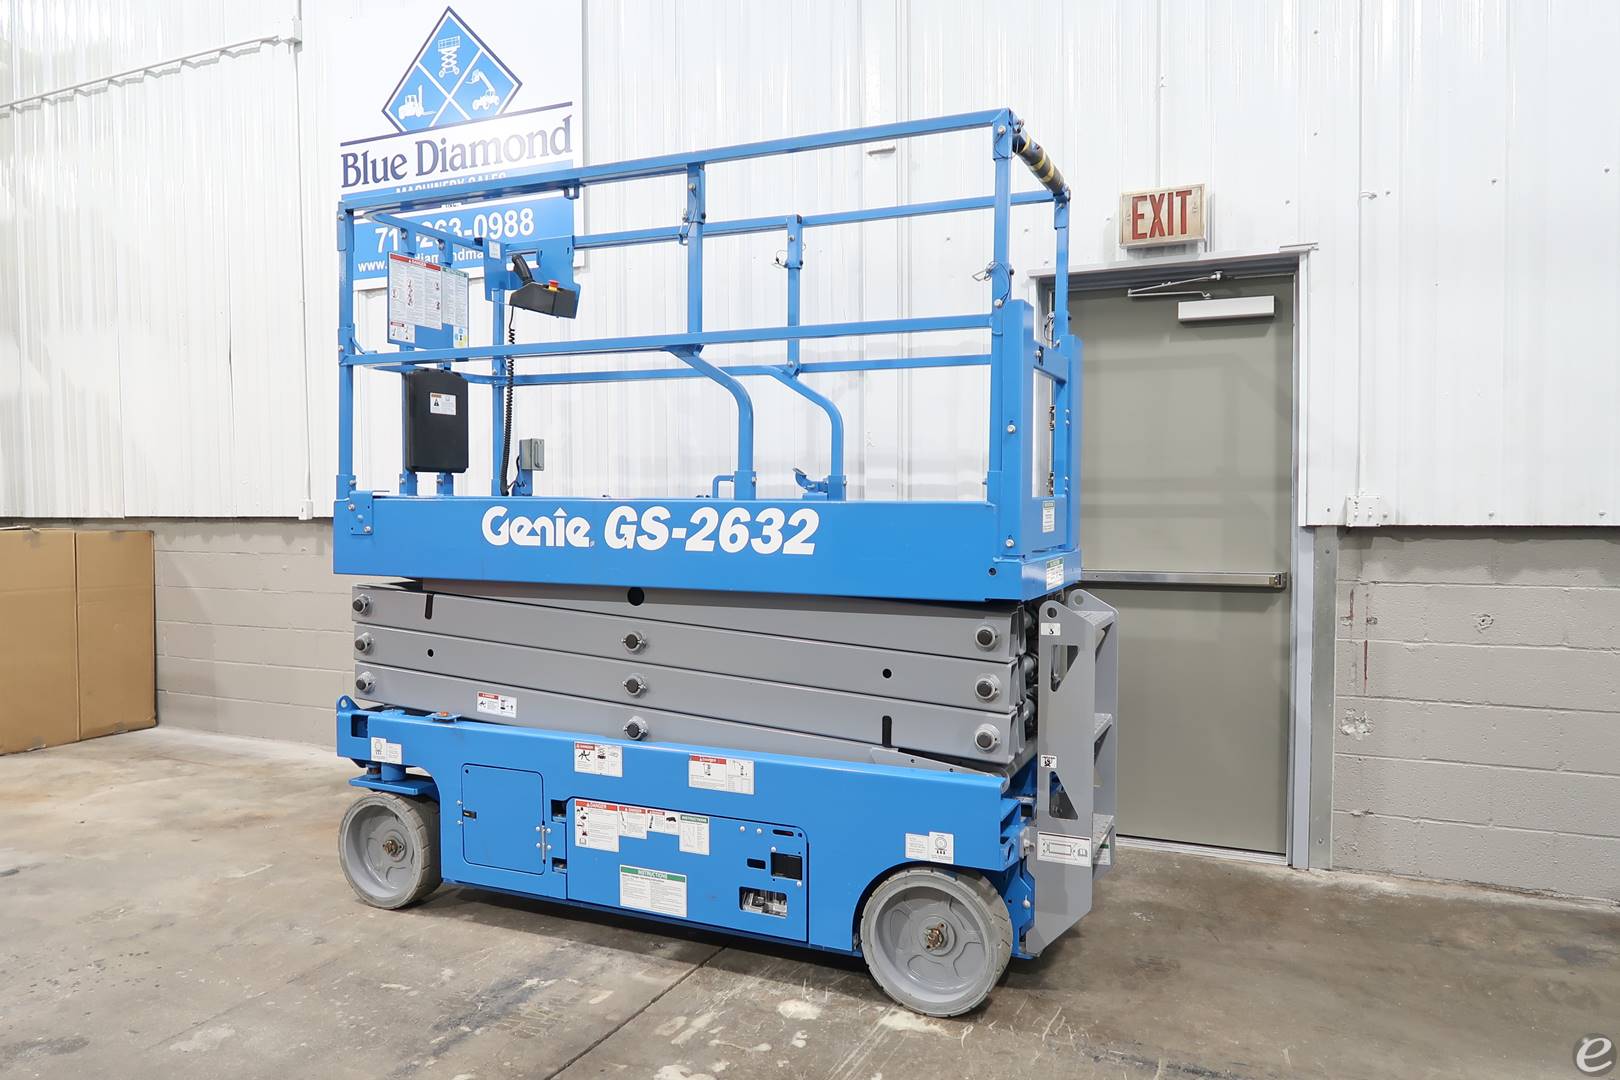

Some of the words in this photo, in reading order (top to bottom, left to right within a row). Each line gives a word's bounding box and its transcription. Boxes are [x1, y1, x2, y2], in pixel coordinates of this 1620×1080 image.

[341, 150, 408, 189] Blue
[415, 114, 573, 177] Diamond
[1131, 189, 1193, 241] EXIT
[481, 505, 591, 548] Genie
[604, 505, 820, 555] GS-2632
